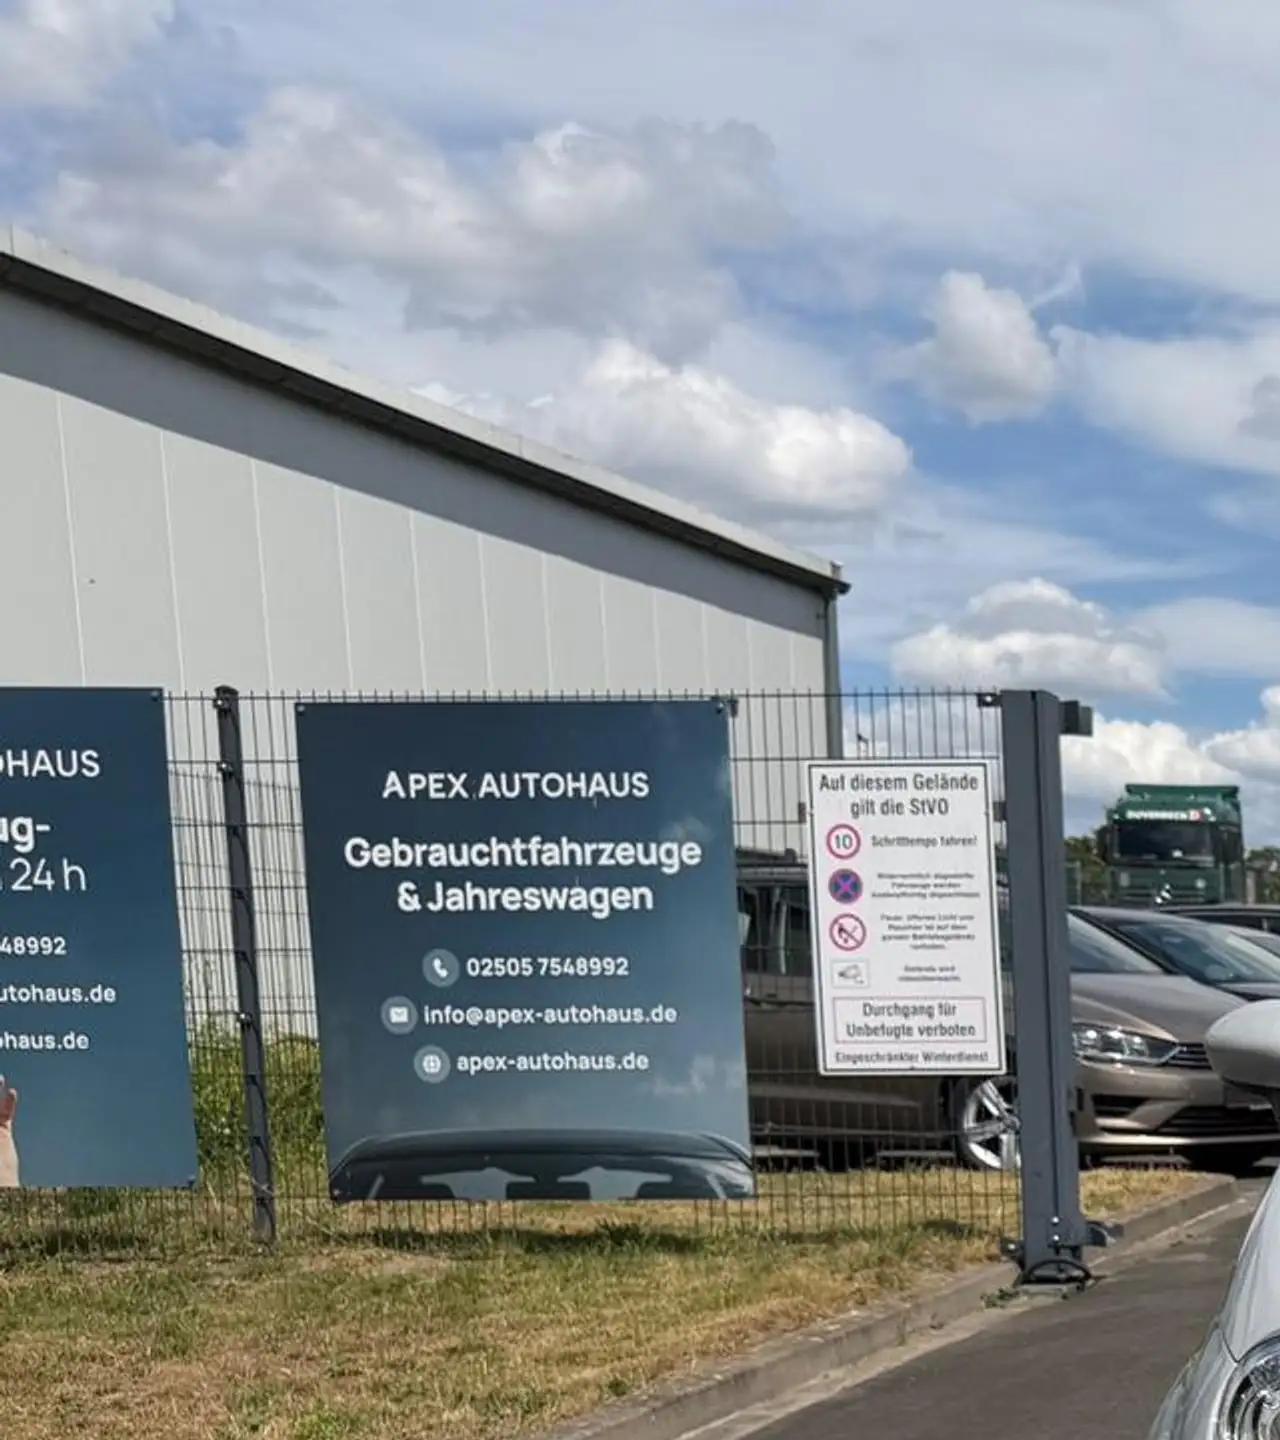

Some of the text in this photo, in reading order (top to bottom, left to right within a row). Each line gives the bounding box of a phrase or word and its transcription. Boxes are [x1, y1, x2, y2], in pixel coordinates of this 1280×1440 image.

[0, 749, 100, 777] HAUS
[382, 771, 650, 799] APEX AUTOHAUS
[819, 774, 979, 792] Auf diesem Gelände
[850, 799, 949, 817] gilt die StVO
[834, 835, 852, 850] 10
[344, 837, 702, 875] Gebrauchtfahrzeuge
[397, 881, 654, 919] & Jahreswagen
[466, 957, 629, 977] 02505 7548992
[424, 1003, 678, 1028] info@apex-autohaus.de
[862, 1001, 957, 1020] Durchgang für
[0, 1031, 90, 1050] haus.de
[846, 1023, 976, 1042] Unbefugte verboten
[456, 1051, 649, 1075] apex-autohaus.de
